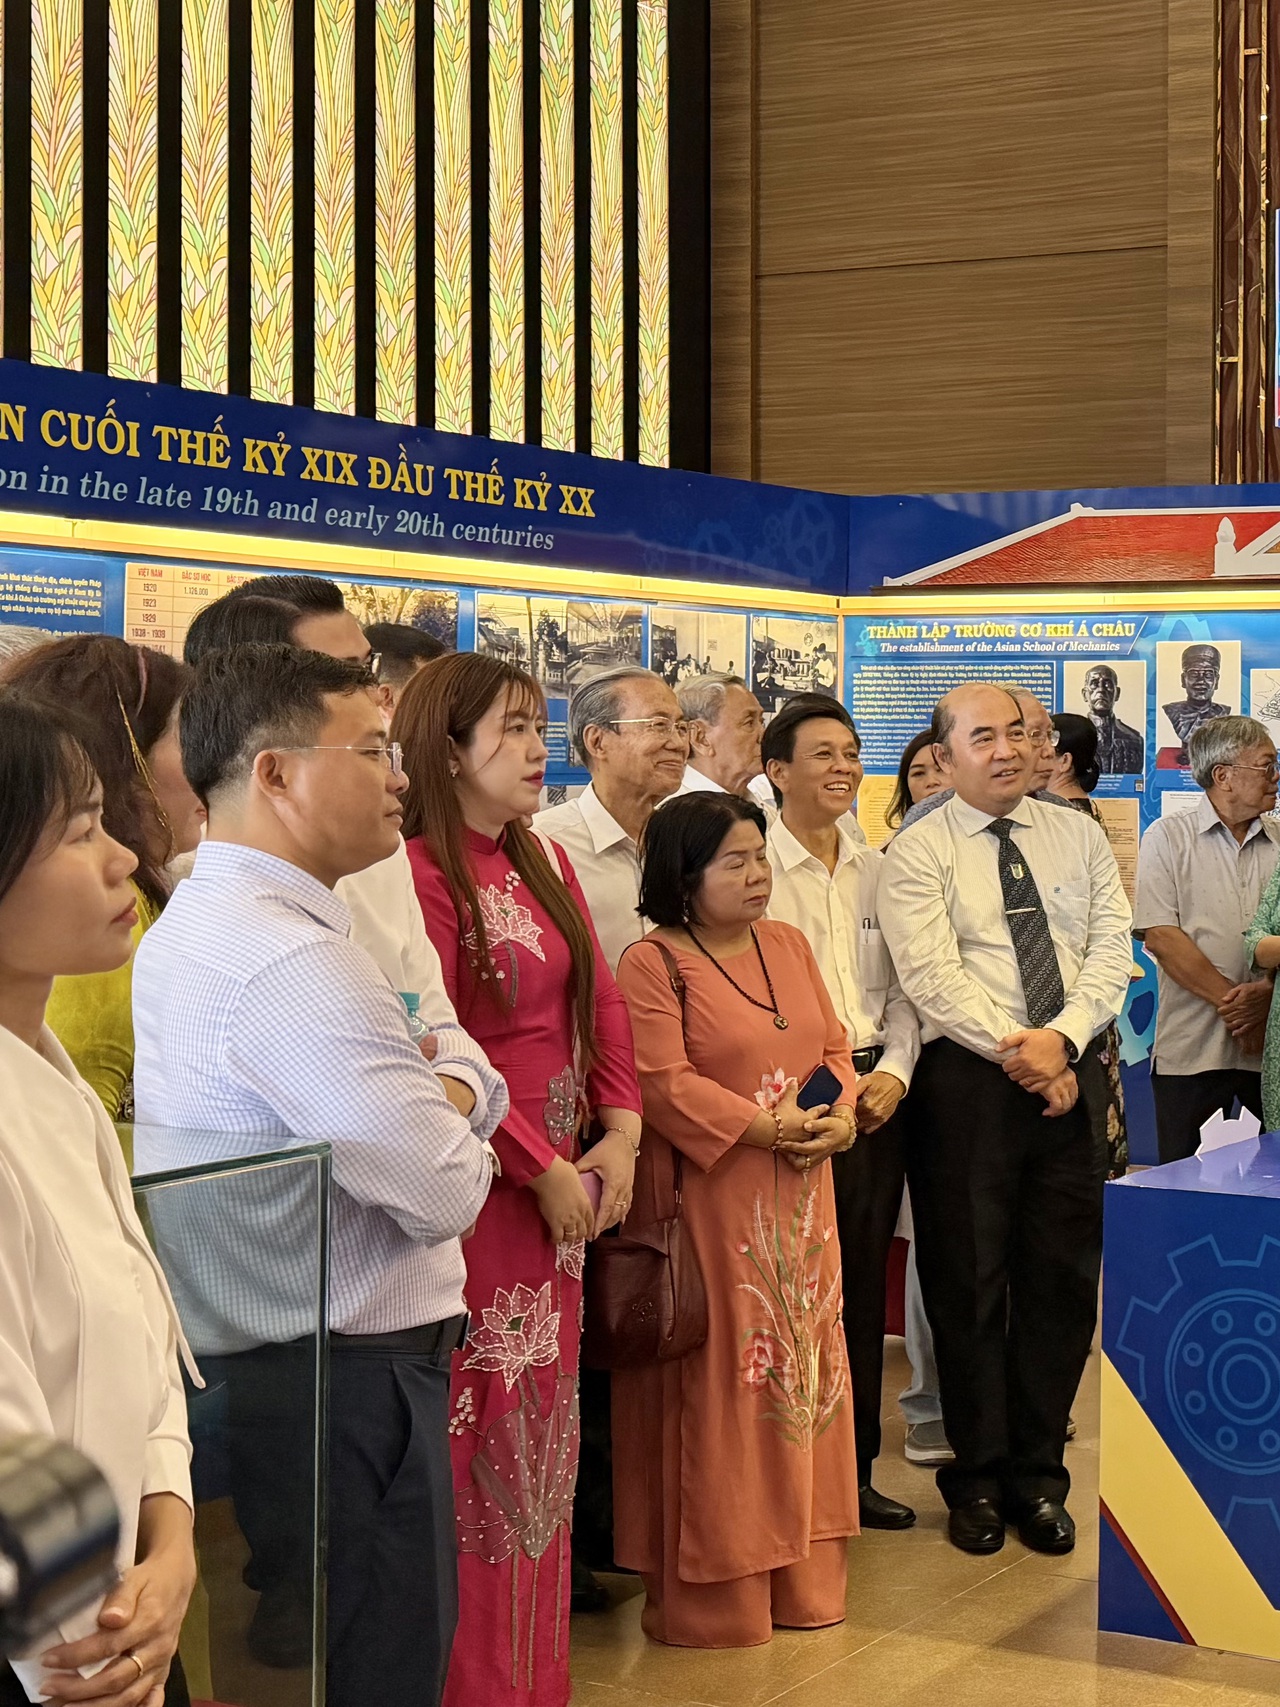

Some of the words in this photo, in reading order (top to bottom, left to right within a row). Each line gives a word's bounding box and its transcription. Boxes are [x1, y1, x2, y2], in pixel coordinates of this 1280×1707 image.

[41, 399, 140, 457] CUỐI
[152, 414, 231, 469] THẾ
[243, 431, 292, 476] KỶ
[300, 447, 359, 486] XIX
[368, 443, 435, 496] ĐẦU
[443, 458, 505, 505] THẾ
[513, 471, 552, 511] KỶ
[558, 484, 596, 517] XX
[37, 465, 69, 495] in
[80, 471, 128, 502] the
[138, 477, 192, 508] late
[200, 485, 259, 516] 19th
[267, 497, 317, 523] and
[324, 505, 389, 536] early
[394, 509, 446, 538] 20th
[452, 524, 555, 550] centuries
[867, 624, 917, 638] THÀNH
[921, 622, 950, 642] LẬP
[954, 621, 1016, 638] TRƯỜNG
[1020, 623, 1042, 638] CƠ
[1045, 620, 1073, 637] KHÍ
[1076, 620, 1090, 637] Á
[1092, 621, 1134, 637] CHÂU
[880, 643, 897, 652] The
[899, 643, 963, 652] establishment
[966, 642, 976, 652] of
[977, 642, 992, 652] the
[994, 642, 1020, 652] Asian
[1022, 642, 1054, 652] School
[1057, 642, 1069, 652] of
[1070, 642, 1120, 652] Mechanics
